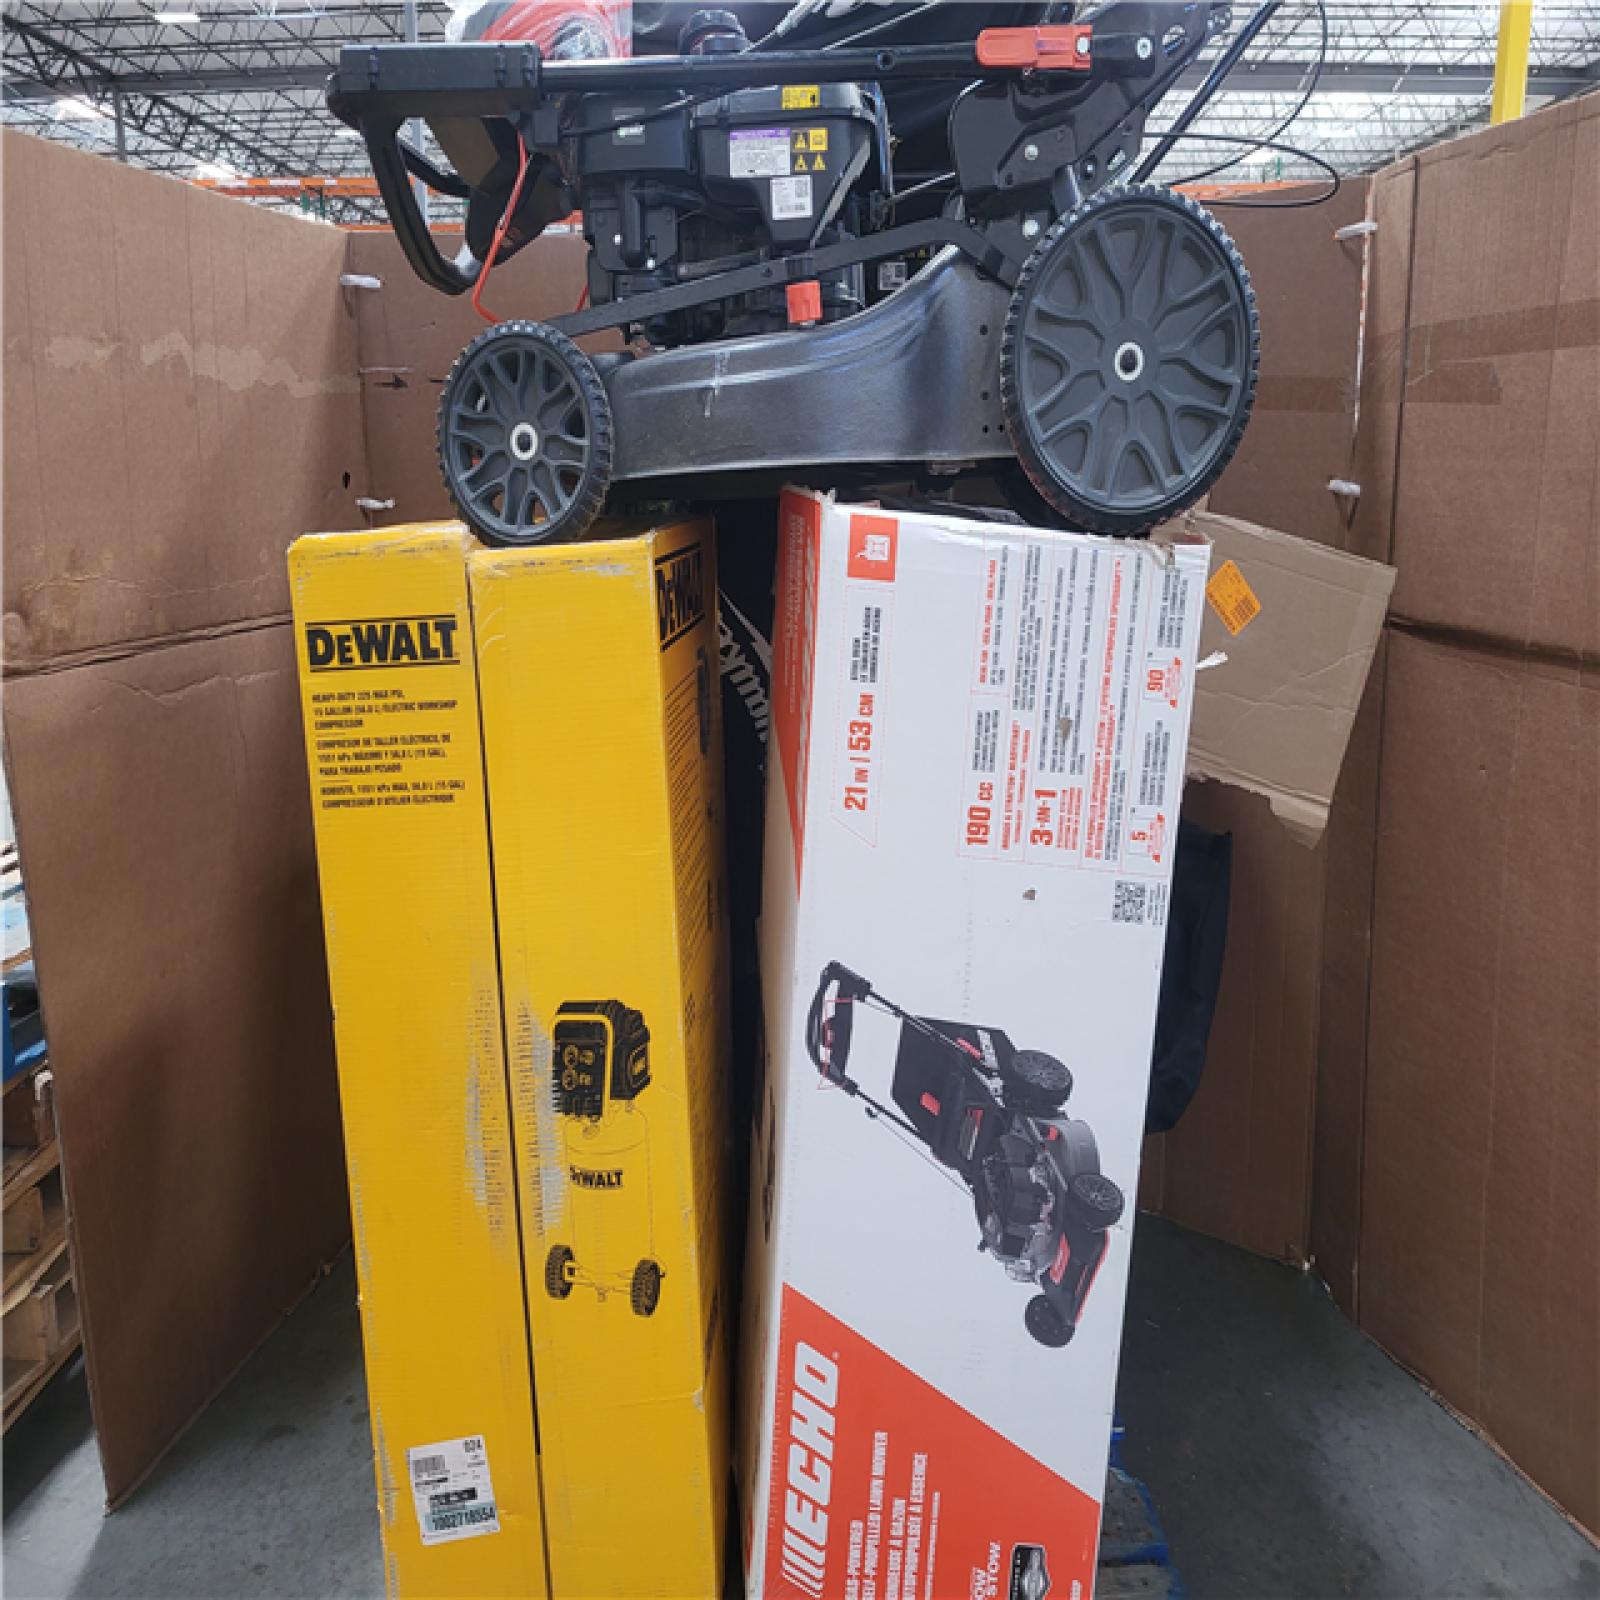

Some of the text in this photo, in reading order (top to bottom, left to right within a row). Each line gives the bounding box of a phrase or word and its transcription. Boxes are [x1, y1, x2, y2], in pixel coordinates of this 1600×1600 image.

[306, 620, 458, 667] DEWALT
[1147, 669, 1164, 691] 90
[848, 720, 873, 752] 53
[845, 787, 869, 812] 21
[1030, 789, 1057, 846] 3-IN-1
[966, 806, 992, 846] 190
[786, 1342, 838, 1544] ECHO
[969, 1567, 987, 1600] OW
